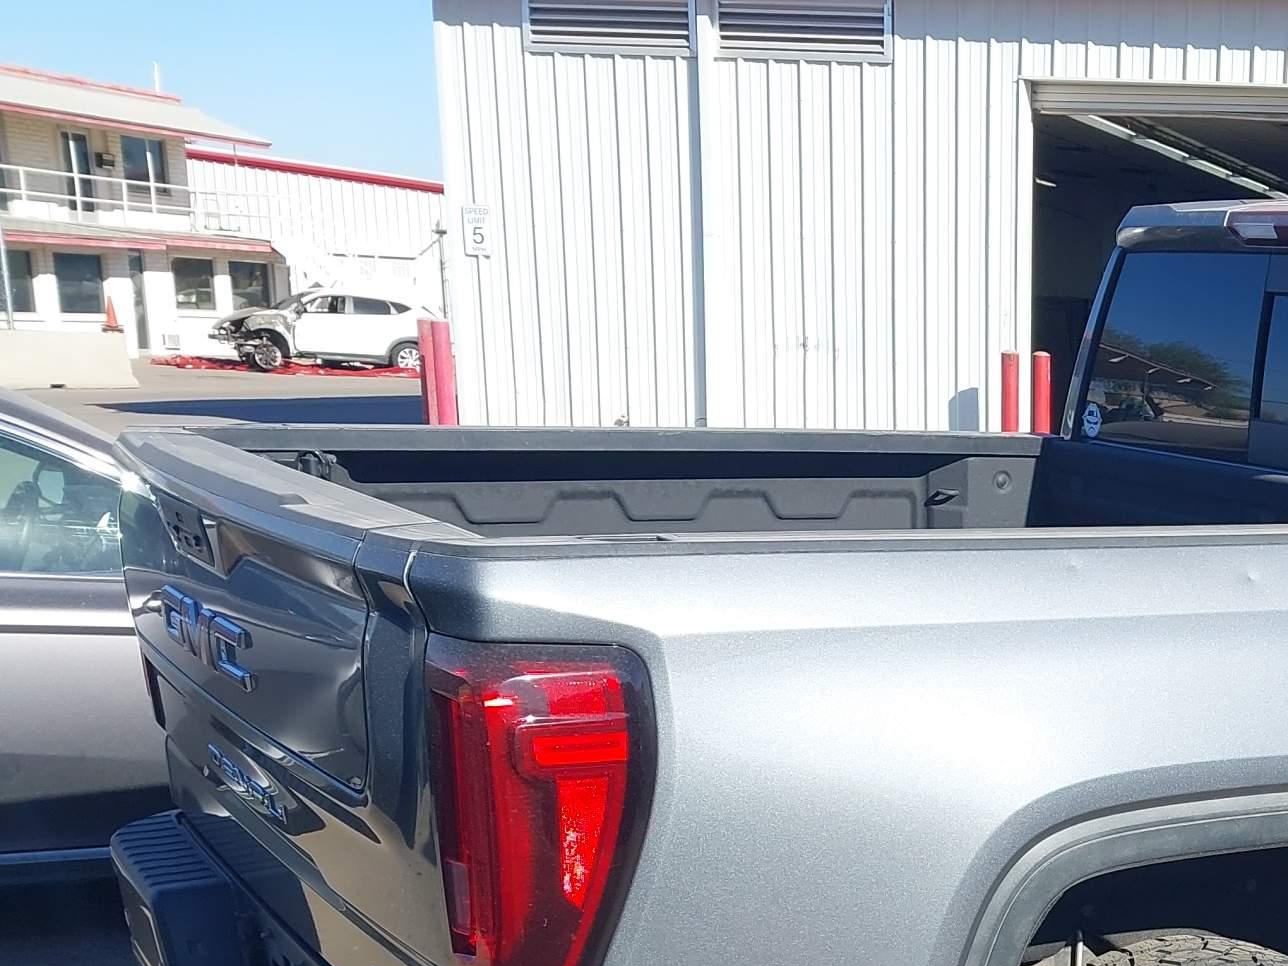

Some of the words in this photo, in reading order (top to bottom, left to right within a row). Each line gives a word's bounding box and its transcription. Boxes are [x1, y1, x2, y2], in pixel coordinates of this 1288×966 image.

[464, 207, 489, 215] SPEED
[467, 216, 486, 224] LIMIT
[472, 226, 485, 245] 5
[160, 584, 254, 692] GMC
[207, 743, 288, 825] DENALI
